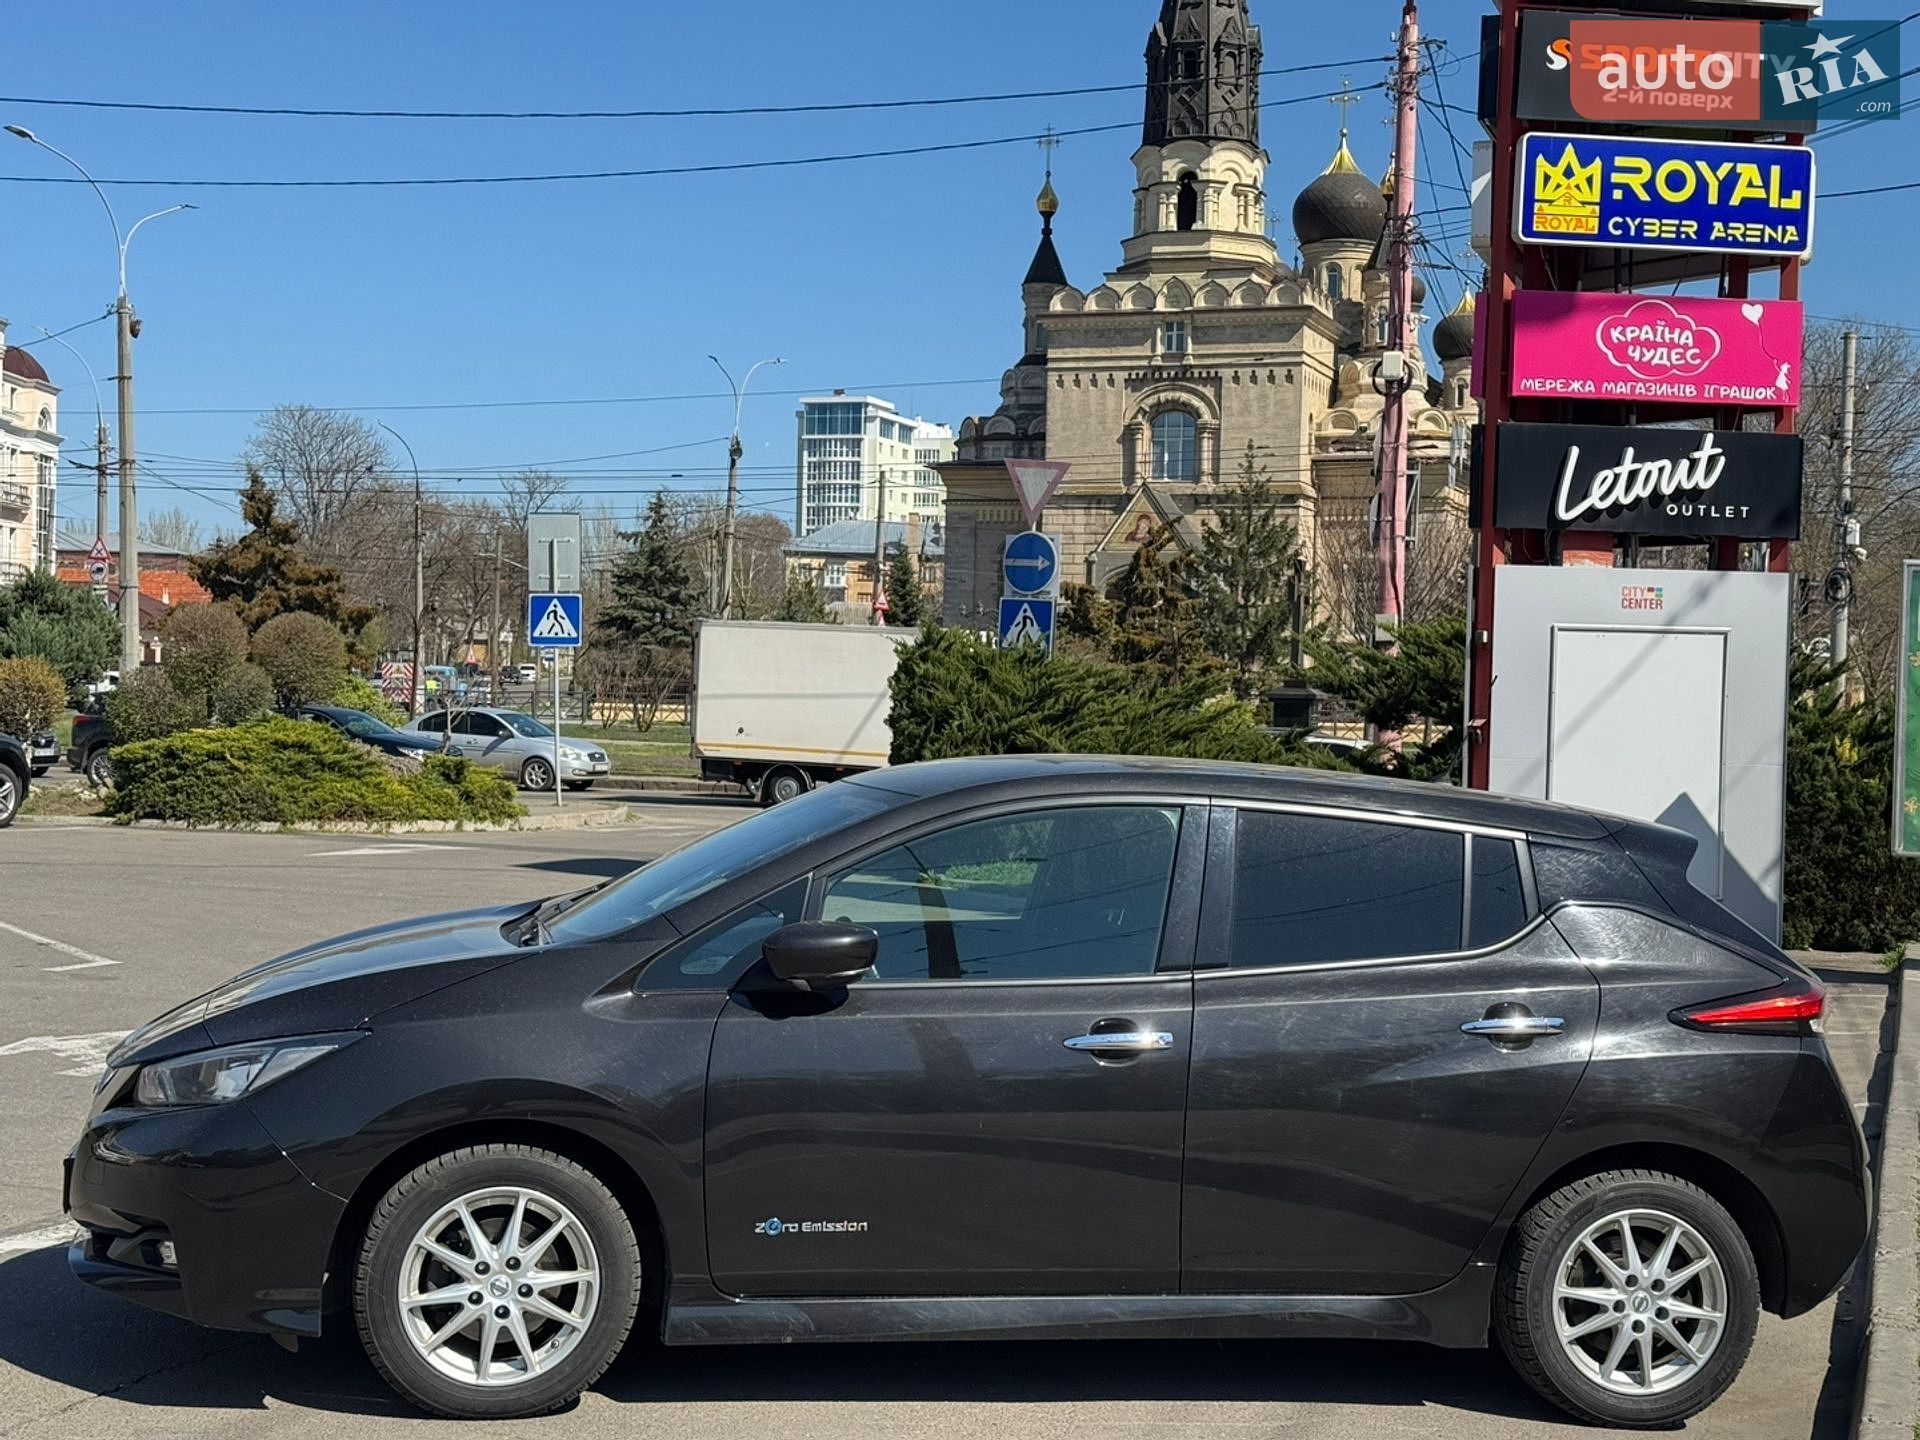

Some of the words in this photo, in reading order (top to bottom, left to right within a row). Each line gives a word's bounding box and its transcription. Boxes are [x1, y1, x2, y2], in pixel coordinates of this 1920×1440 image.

[1649, 89, 1733, 112] поверх
[1611, 156, 1801, 209] ROYAL
[1535, 216, 1596, 231] ROYAL
[1608, 216, 1698, 239] CYBER
[1710, 221, 1799, 243] ARENA
[1610, 320, 1694, 347] КРАЇНА
[1627, 345, 1701, 367] ЧУДЕС
[1520, 378, 1596, 393] МЕРЕЖА
[1601, 380, 1697, 397] МАГАЗИНІВ
[1703, 384, 1776, 400] ІГРАШОК
[1555, 432, 1726, 521] Letout
[1666, 503, 1750, 519] OUTLET
[1621, 586, 1646, 597] CITY
[1621, 598, 1663, 609] CENTER
[801, 1220, 868, 1232] Emission
